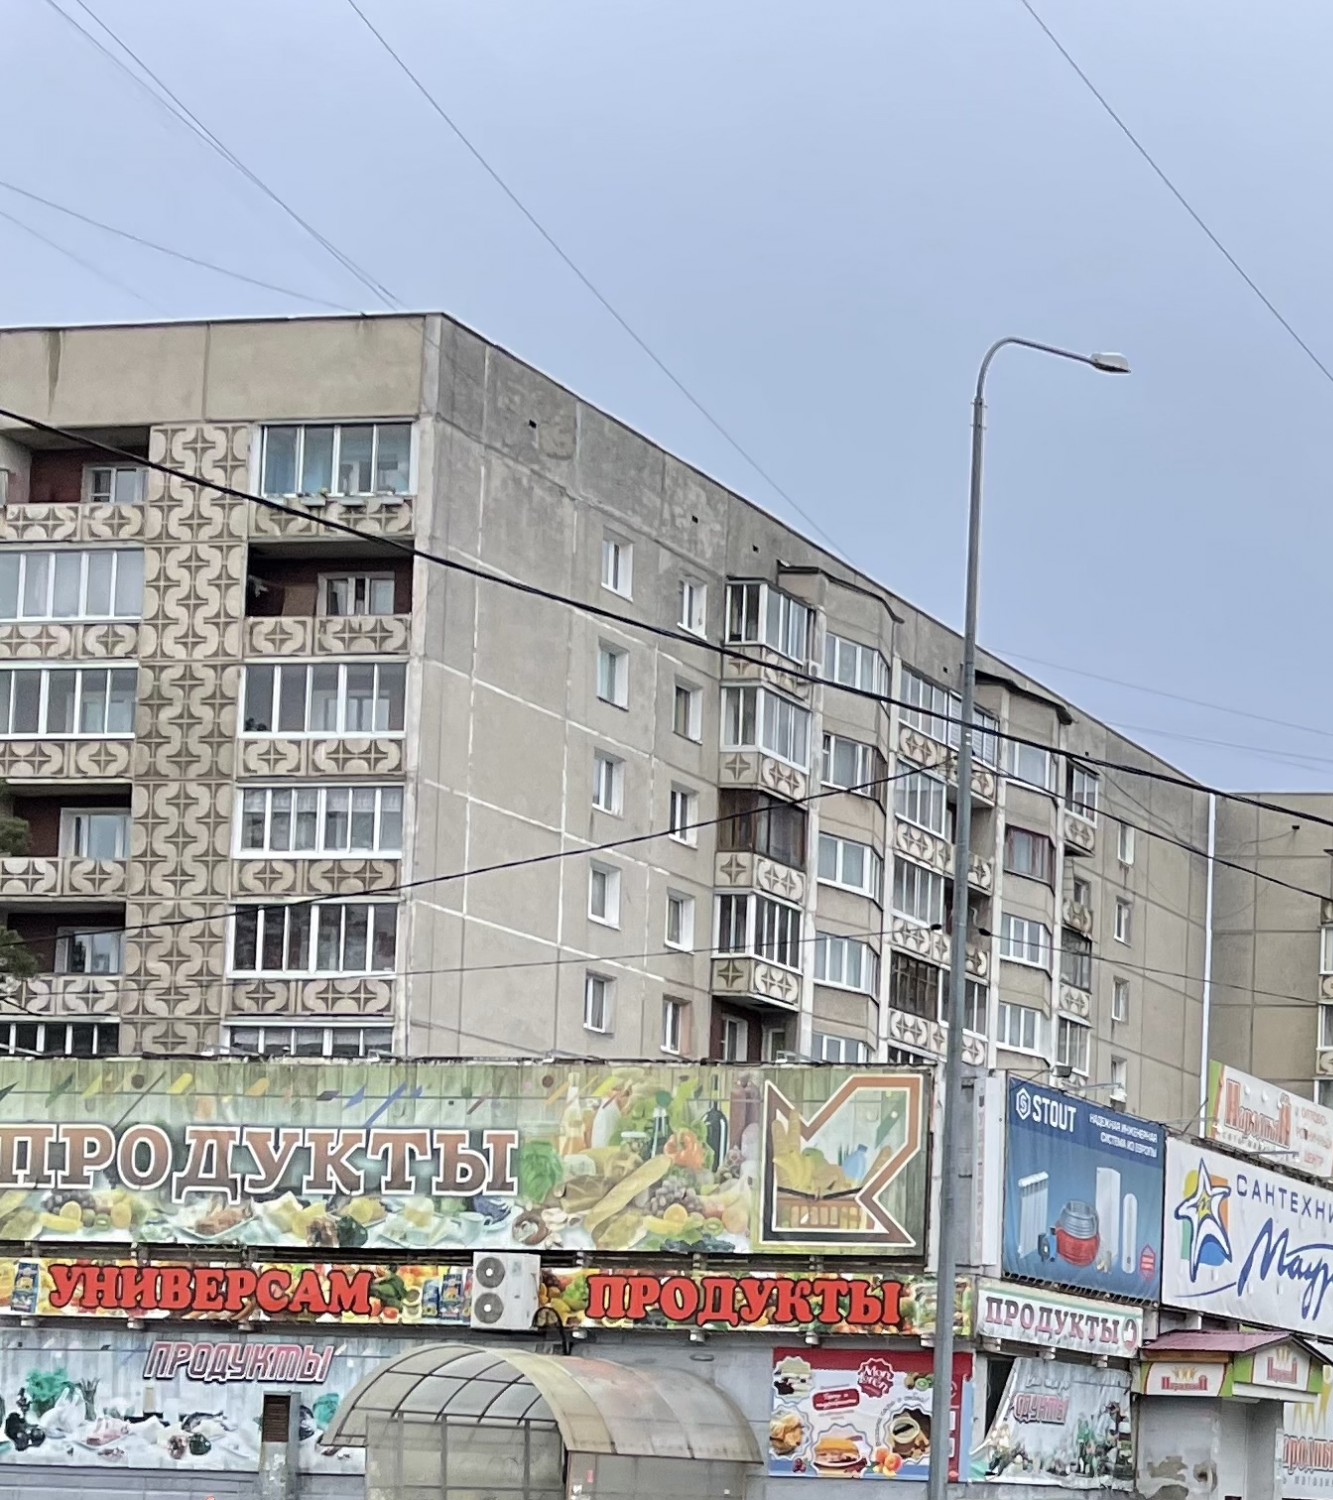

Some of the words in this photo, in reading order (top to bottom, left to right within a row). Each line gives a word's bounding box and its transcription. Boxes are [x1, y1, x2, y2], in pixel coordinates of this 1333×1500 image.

[1032, 1095, 1077, 1132] STOUT
[0, 1123, 519, 1204] ПРОДУКТЫ
[49, 1264, 374, 1315] УНИВЕРСАМ
[585, 1274, 903, 1327] ПРОДУКТЫ
[985, 1296, 1120, 1345] ПРОДУКТЫ
[143, 1341, 335, 1384] ПРОДУКТЫ
